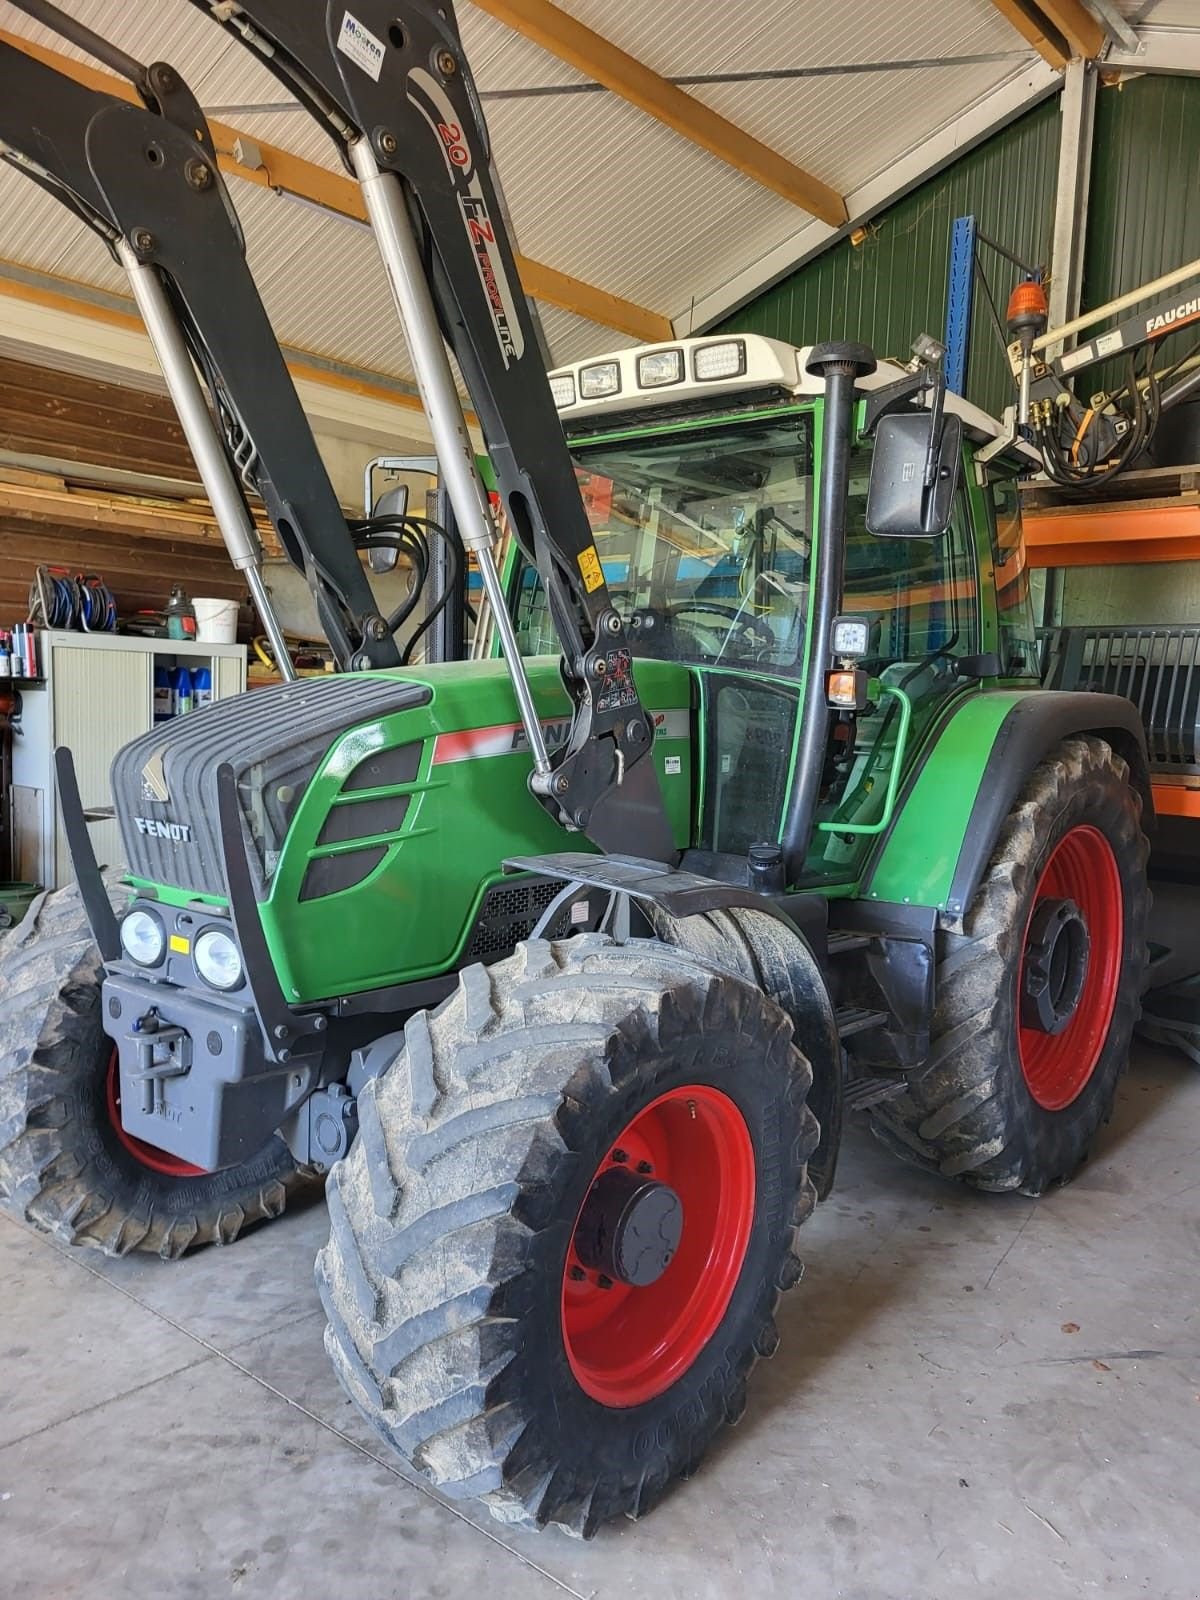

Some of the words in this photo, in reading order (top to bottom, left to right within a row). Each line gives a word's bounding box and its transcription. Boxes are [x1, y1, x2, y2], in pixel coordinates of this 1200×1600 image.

[438, 123, 469, 167] 20
[460, 196, 495, 245] FZ
[134, 816, 190, 842] FENDT
